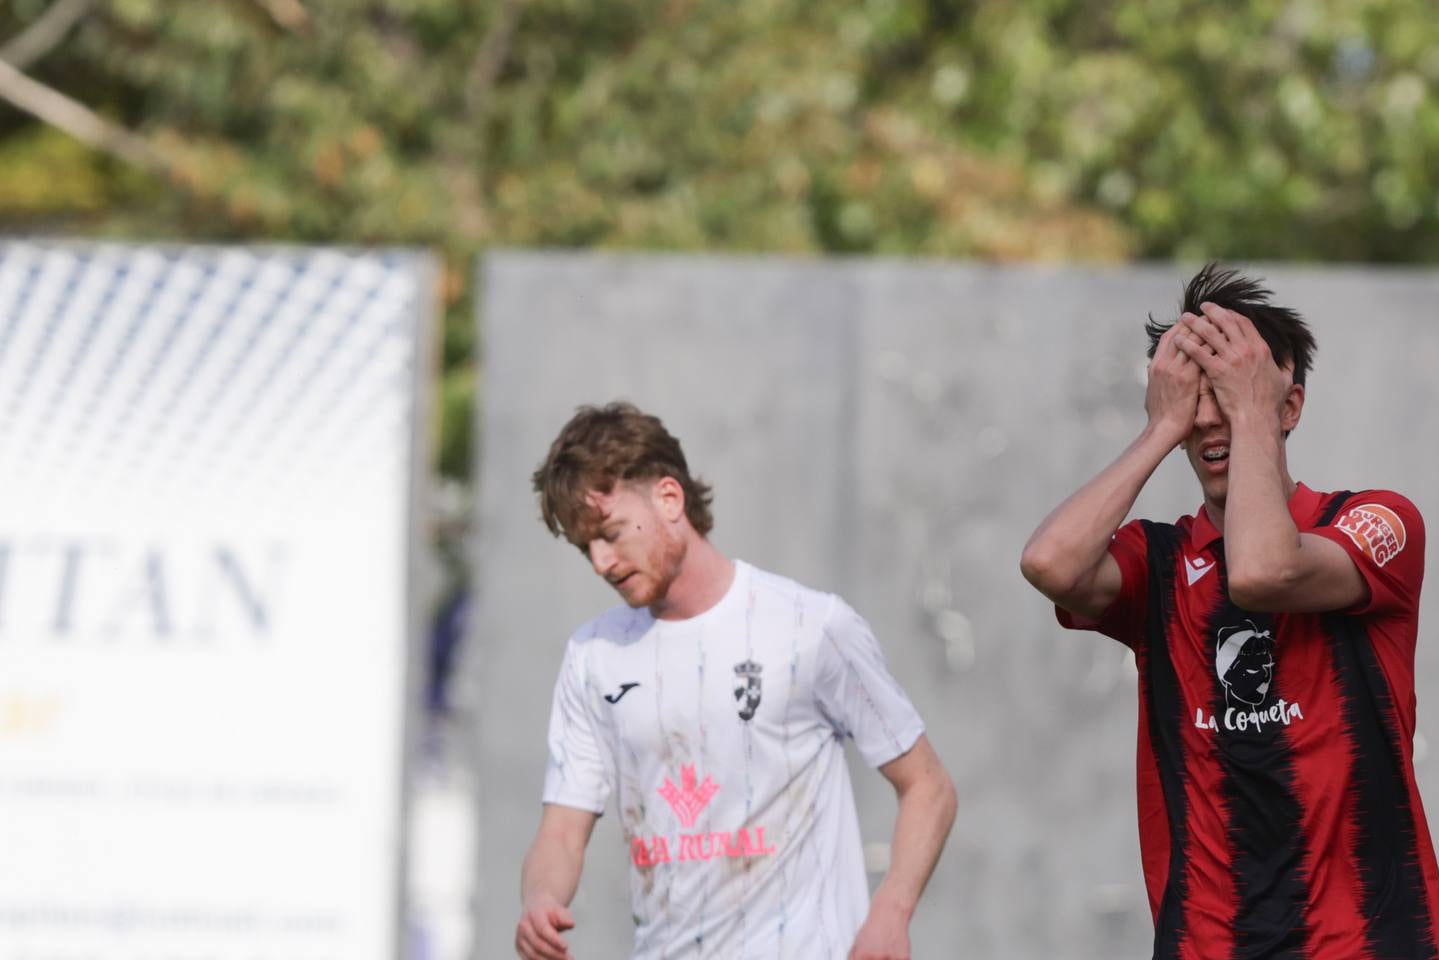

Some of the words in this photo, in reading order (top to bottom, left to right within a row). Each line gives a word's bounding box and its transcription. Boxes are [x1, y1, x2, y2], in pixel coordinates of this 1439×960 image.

[1340, 515, 1389, 565] KING
[1351, 510, 1399, 557] BURGER
[1194, 707, 1219, 733] La
[1224, 698, 1304, 733] Coqueta
